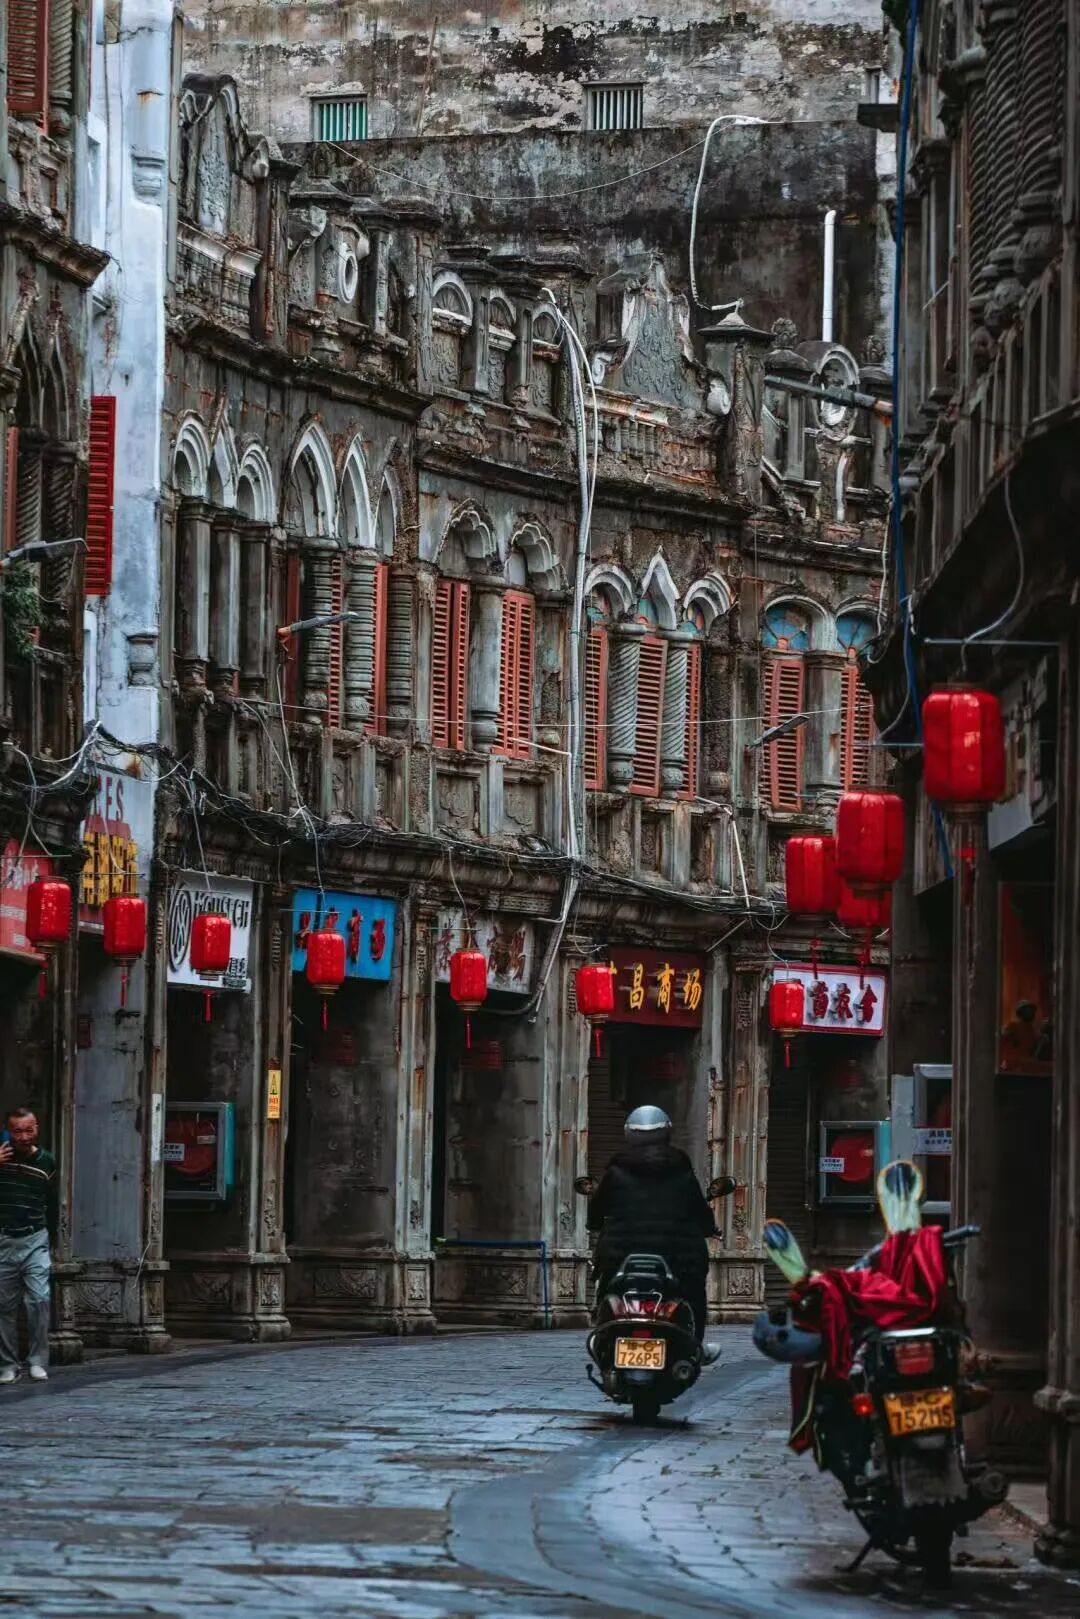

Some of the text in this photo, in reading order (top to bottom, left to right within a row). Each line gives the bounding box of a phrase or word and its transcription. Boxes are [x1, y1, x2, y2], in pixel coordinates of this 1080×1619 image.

[608, 960, 702, 1014] 昌商场
[620, 1351, 660, 1365] 726P5
